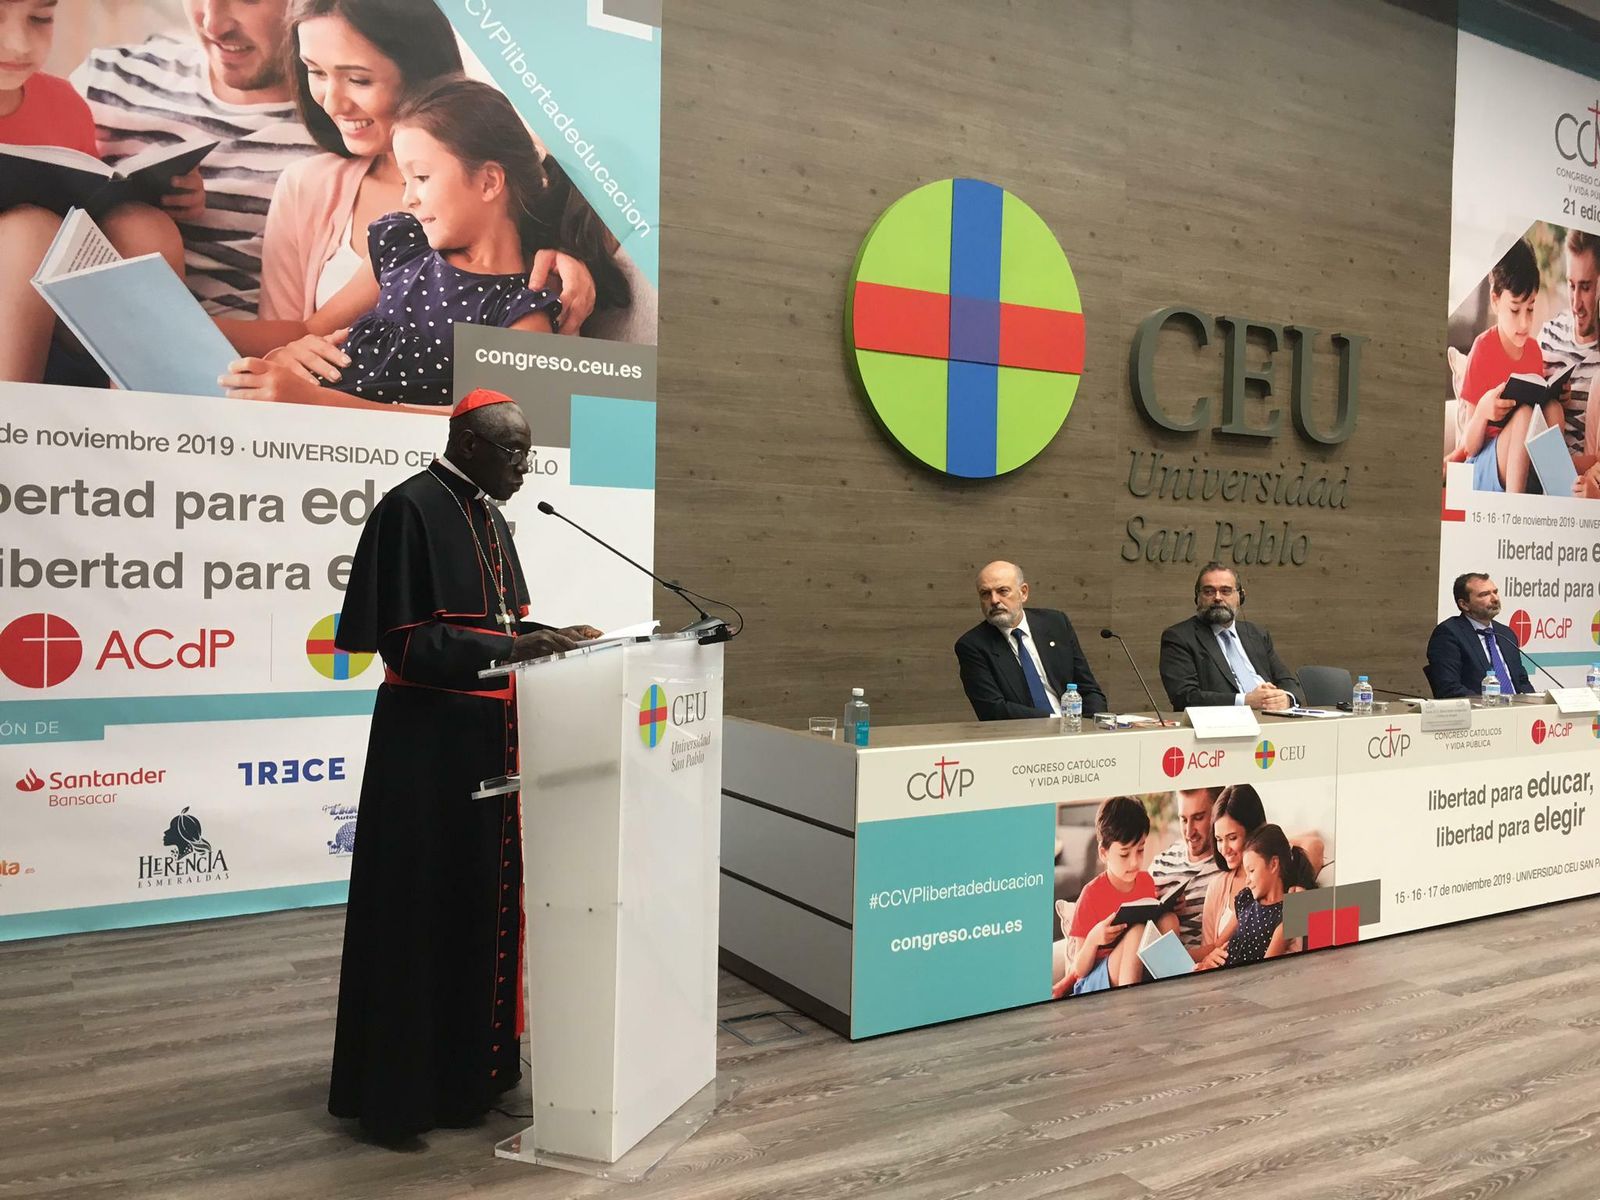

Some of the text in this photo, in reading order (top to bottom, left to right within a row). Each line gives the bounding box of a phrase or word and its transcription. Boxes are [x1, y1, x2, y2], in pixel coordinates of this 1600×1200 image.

[1556, 167, 1593, 185] CONGRESO
[1568, 184, 1573, 193] Y
[1574, 185, 1589, 197] VIDA
[1563, 197, 1576, 215] 21
[475, 348, 642, 379] congreso.ceu.es
[1129, 306, 1368, 444] CEU
[0, 422, 28, 444] de
[36, 427, 169, 452] noviembre
[177, 433, 234, 456] 2019
[252, 440, 399, 466] UNIVERSIDAD
[404, 450, 437, 467] CE
[1127, 449, 1350, 510] Universidad
[175, 489, 285, 530] para
[1472, 511, 1482, 523] 15
[1487, 512, 1497, 524] 16
[1502, 513, 1511, 525] 17
[1512, 514, 1521, 525] de
[1523, 515, 1558, 527] noviembre
[1559, 516, 1575, 528] 2019
[1120, 515, 1311, 567] San Pablo
[1497, 539, 1553, 561] libertad
[1557, 546, 1588, 566] para
[203, 560, 310, 599] para
[1504, 576, 1594, 602] libertad para
[1534, 617, 1573, 639] ACdP
[95, 628, 235, 670] ACdP
[672, 690, 708, 727] CEU
[35, 720, 59, 735] DE
[1434, 730, 1468, 740] CONGRESO
[1548, 722, 1573, 738] ACdP
[671, 731, 711, 755] Universidad
[1279, 745, 1306, 762] CEU
[1367, 733, 1411, 760] CCVP
[1450, 742, 1465, 750] VIDA
[671, 751, 705, 773] San Pablo
[1012, 757, 1117, 775] CONGRESO CATÓLICOS
[1187, 749, 1225, 769] ACdP
[49, 767, 166, 791] Santander
[906, 767, 974, 801] CCVP
[1029, 772, 1100, 787] Y VIDA PÚBLICA
[1428, 771, 1594, 811] libertad para educar,
[48, 792, 117, 807] Bansacar
[1436, 802, 1586, 847] libertad para elegir
[138, 873, 229, 889] ESMERALDAS
[868, 872, 1044, 910] #CCVPlibertadeducacion
[1395, 891, 1405, 904] 15
[1412, 888, 1422, 900] 16
[1428, 885, 1438, 898] 17
[1439, 884, 1450, 896] de
[1451, 877, 1492, 894] noviembre
[1493, 873, 1512, 886] 2019
[1515, 865, 1563, 882] UNIVERSIDAD
[1564, 862, 1579, 873] CEU
[1579, 859, 1594, 871] SAN
[890, 919, 1023, 952] congreso.ceu.es
